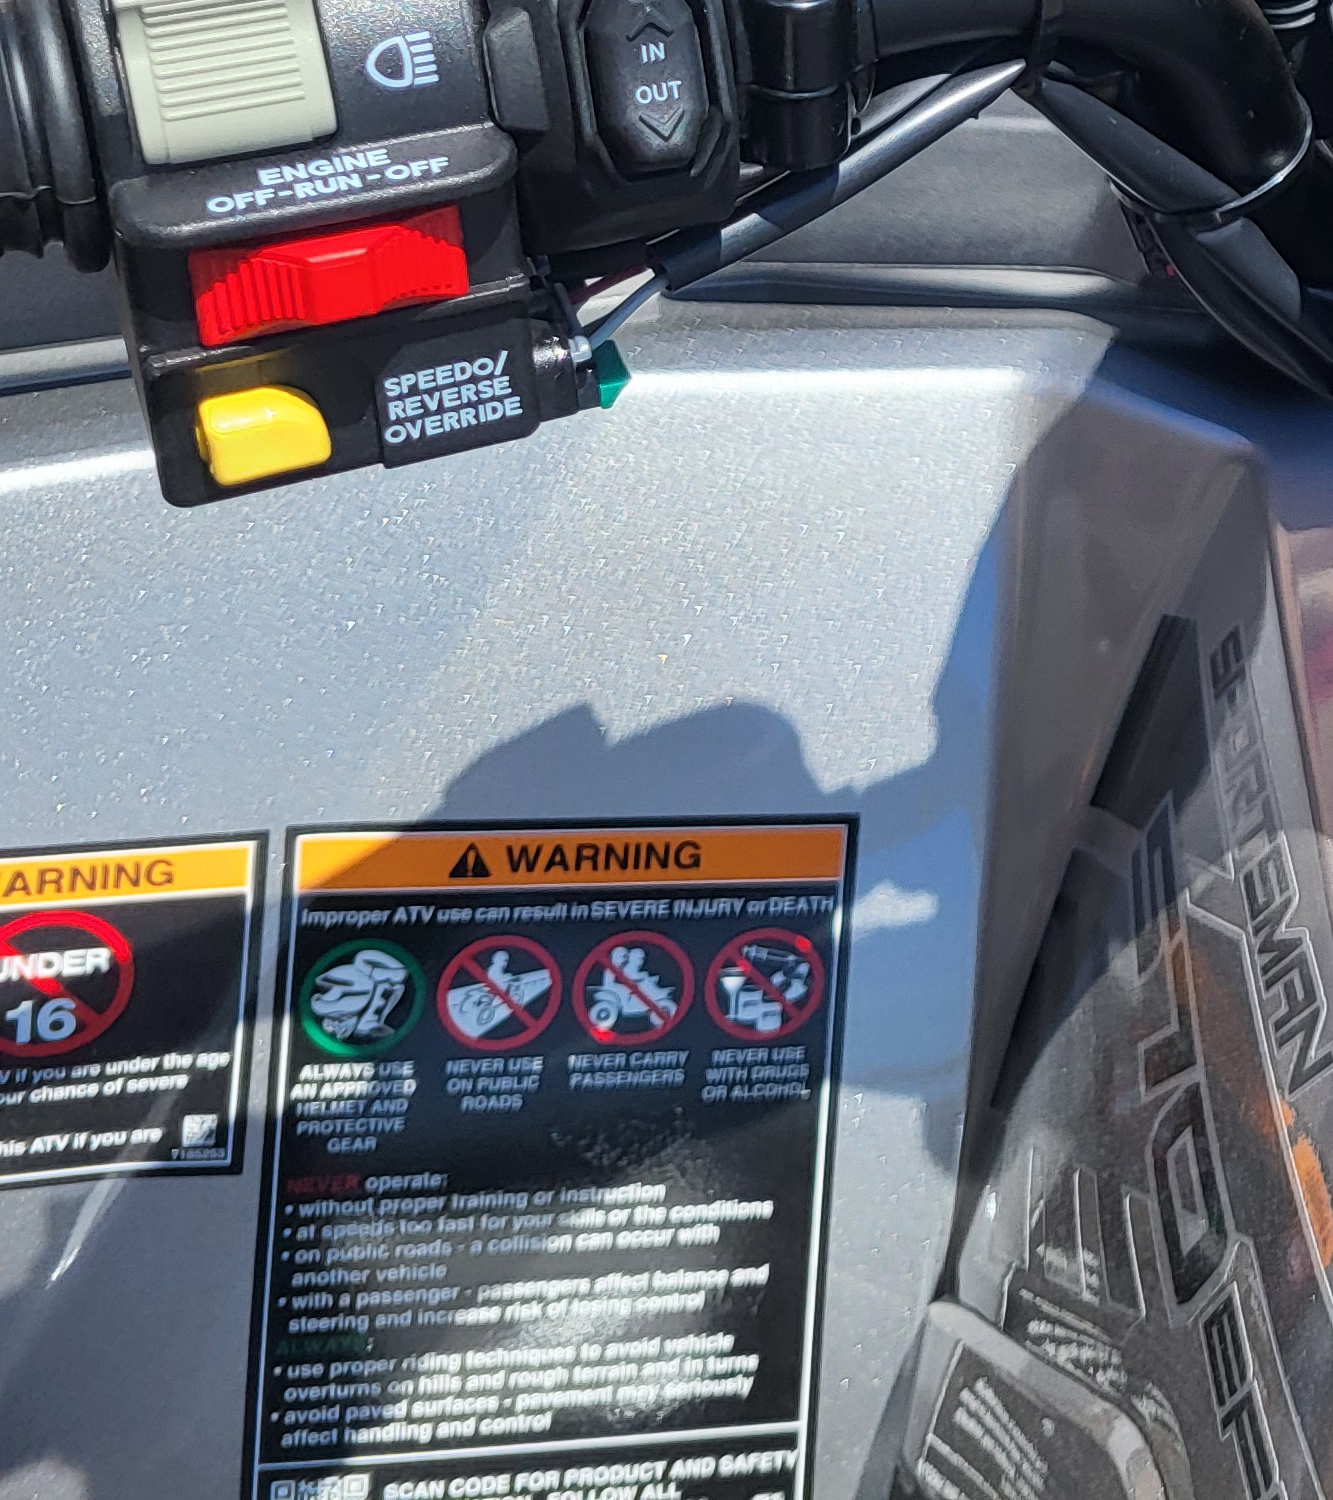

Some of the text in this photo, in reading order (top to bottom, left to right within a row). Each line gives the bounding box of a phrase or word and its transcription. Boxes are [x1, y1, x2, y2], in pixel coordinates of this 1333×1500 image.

[641, 41, 666, 64] IN
[635, 80, 683, 105] OUT
[257, 148, 391, 187] ENGINE
[388, 376, 513, 422] REVERSE
[384, 400, 523, 445] OVERRIDE
[506, 841, 702, 875] WARNING
[0, 859, 175, 898] ARNING
[300, 896, 836, 929] Improper ATV can result SEVERE INJURY DEATH
[6, 997, 77, 1045] 16
[105, 1051, 231, 1077] under the age
[299, 1060, 416, 1082] ALWAYS USE
[445, 1056, 545, 1076] NEVER USE
[568, 1050, 691, 1072] NEVER CARRY
[712, 1048, 769, 1066] NEVER
[29, 1073, 190, 1103] chance severe
[289, 1078, 418, 1101] AN APPROVED
[446, 1075, 542, 1095] ON PUBLIC
[569, 1069, 686, 1091] PASSENGERS
[705, 1066, 748, 1085] WITH
[296, 1098, 409, 1118] HELMET AND
[459, 1094, 524, 1113] ROADS
[296, 1116, 406, 1136] PROTECTIVE
[29, 1127, 165, 1155] ATV are
[326, 1135, 378, 1154] GEAR
[286, 1173, 361, 1194] NEVER
[298, 1181, 667, 1219] without proper training instruction
[320, 1198, 775, 1242] speeds too the conditions
[294, 1223, 721, 1266] on public roads collision can occur with
[291, 1262, 449, 1288] another vehicle
[291, 1267, 730, 1311] with passenger passengers balance
[288, 1303, 502, 1335] steering and increase
[286, 1331, 735, 1380] use proper riding techniques avoid vehicle
[283, 1353, 760, 1404] overturns on hills and rough terrain turns
[282, 1374, 756, 1426] avoid paved surfaces pavement seriously
[281, 1410, 553, 1449] affect handling and control
[384, 1449, 800, 1500] SCAN CODE FOR PRODUCT AND SAFETY
